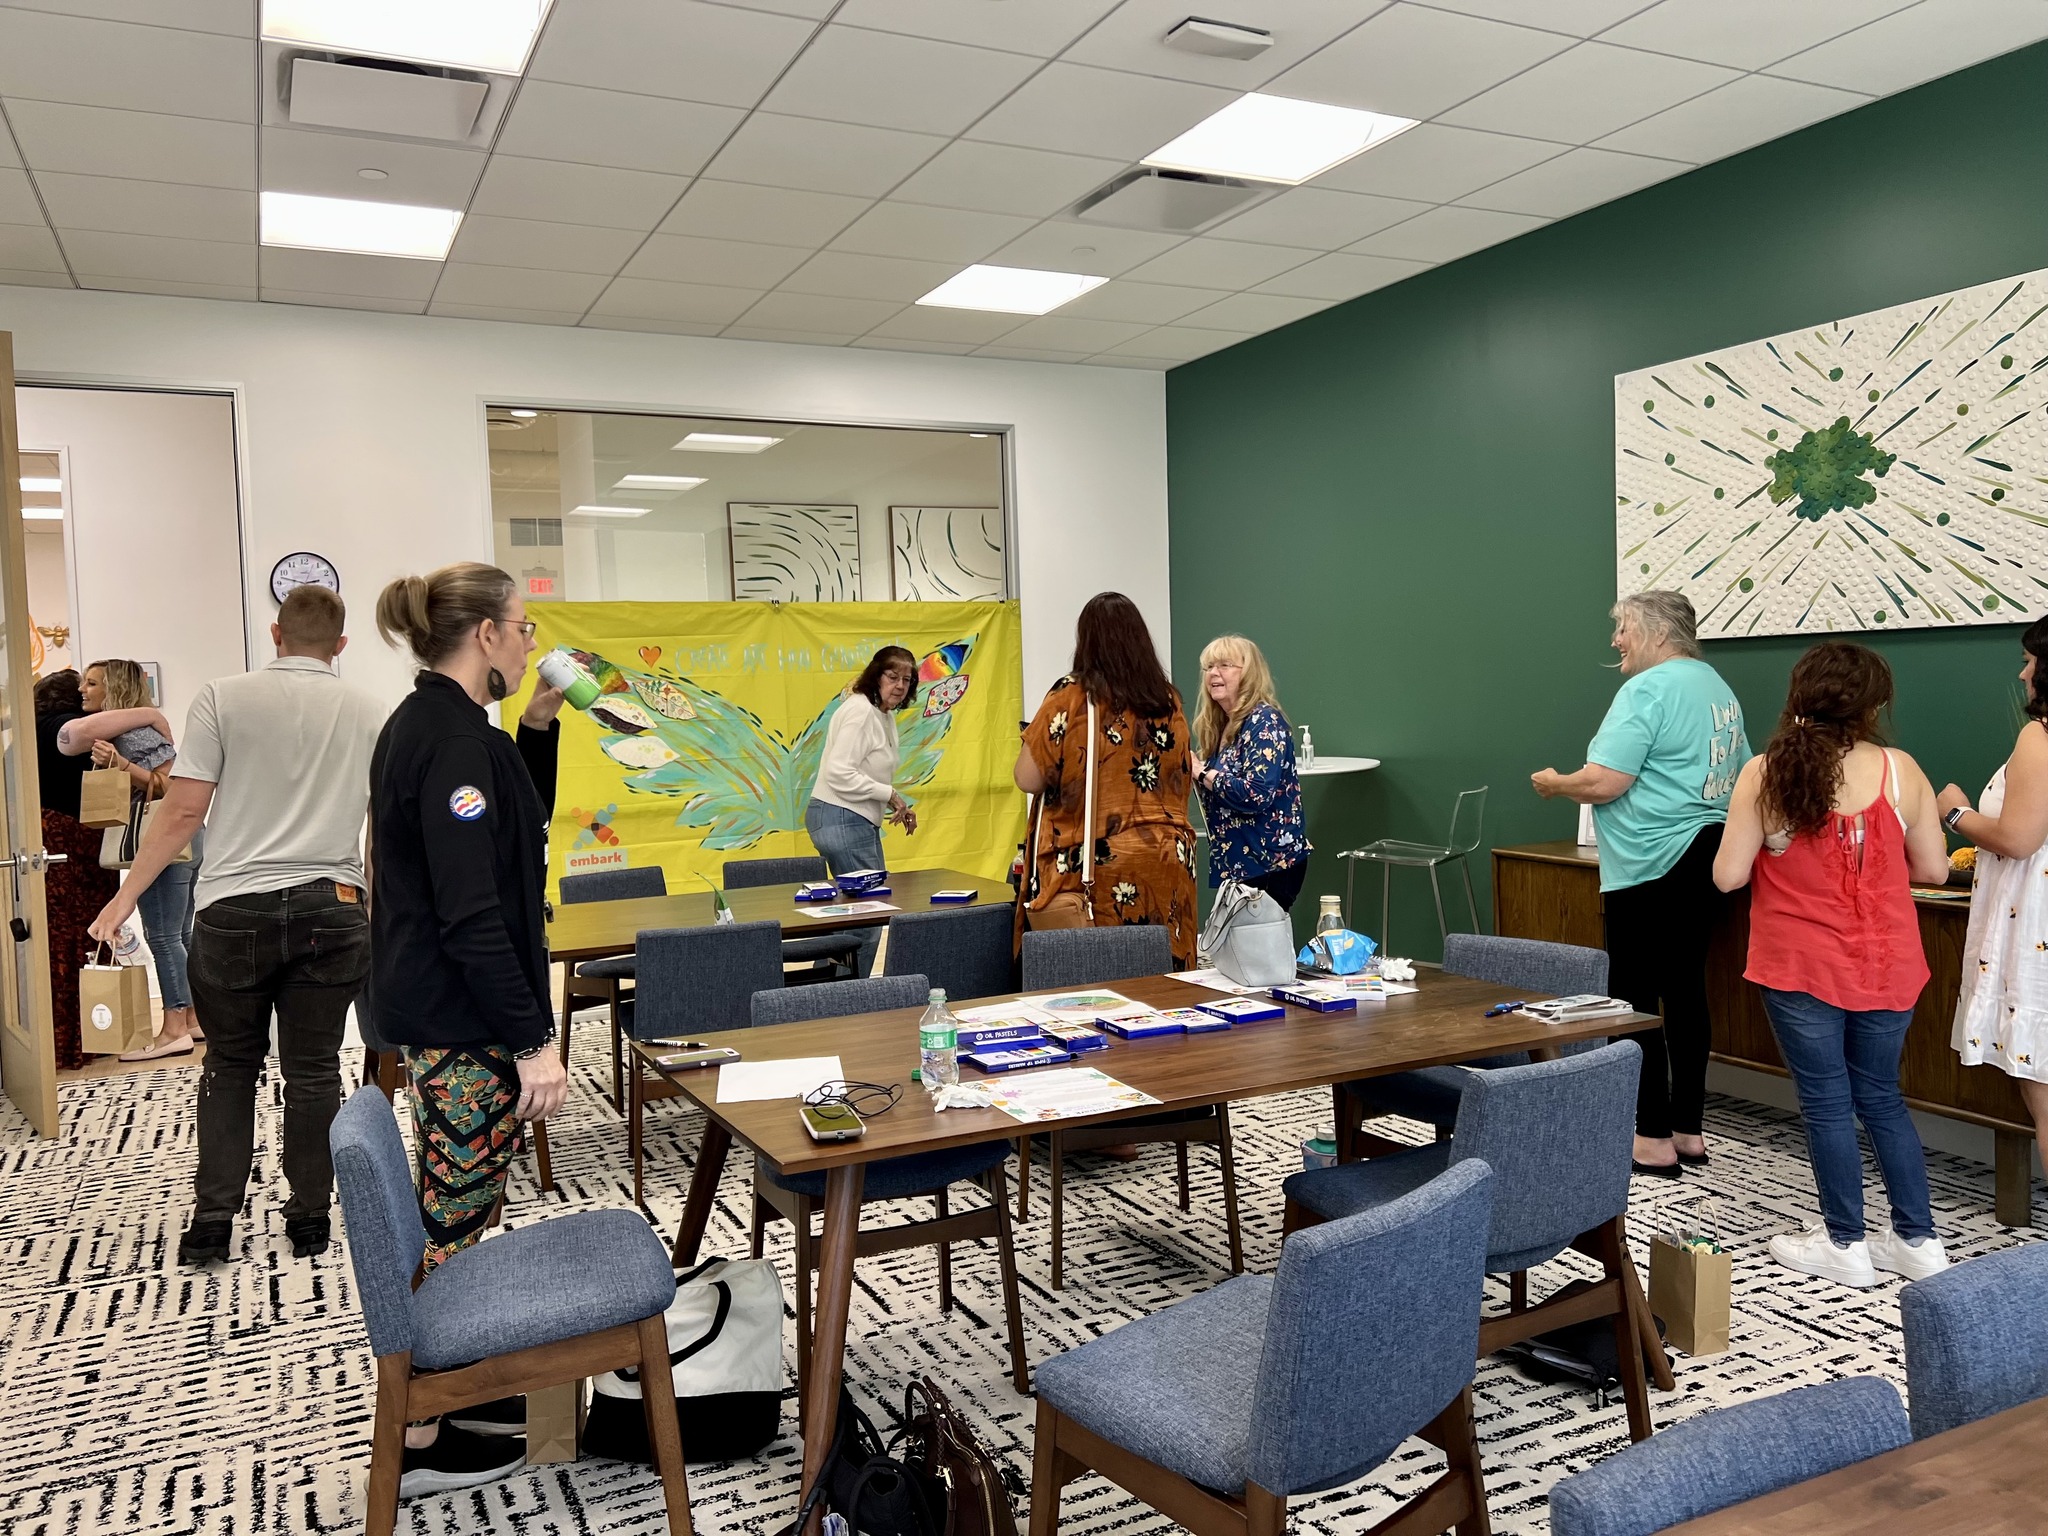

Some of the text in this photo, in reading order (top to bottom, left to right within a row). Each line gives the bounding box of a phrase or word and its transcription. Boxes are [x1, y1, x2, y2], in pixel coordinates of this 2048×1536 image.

[529, 578, 552, 594] EXIT
[570, 852, 622, 867] embark
[995, 1030, 1018, 1038] PASTELS
